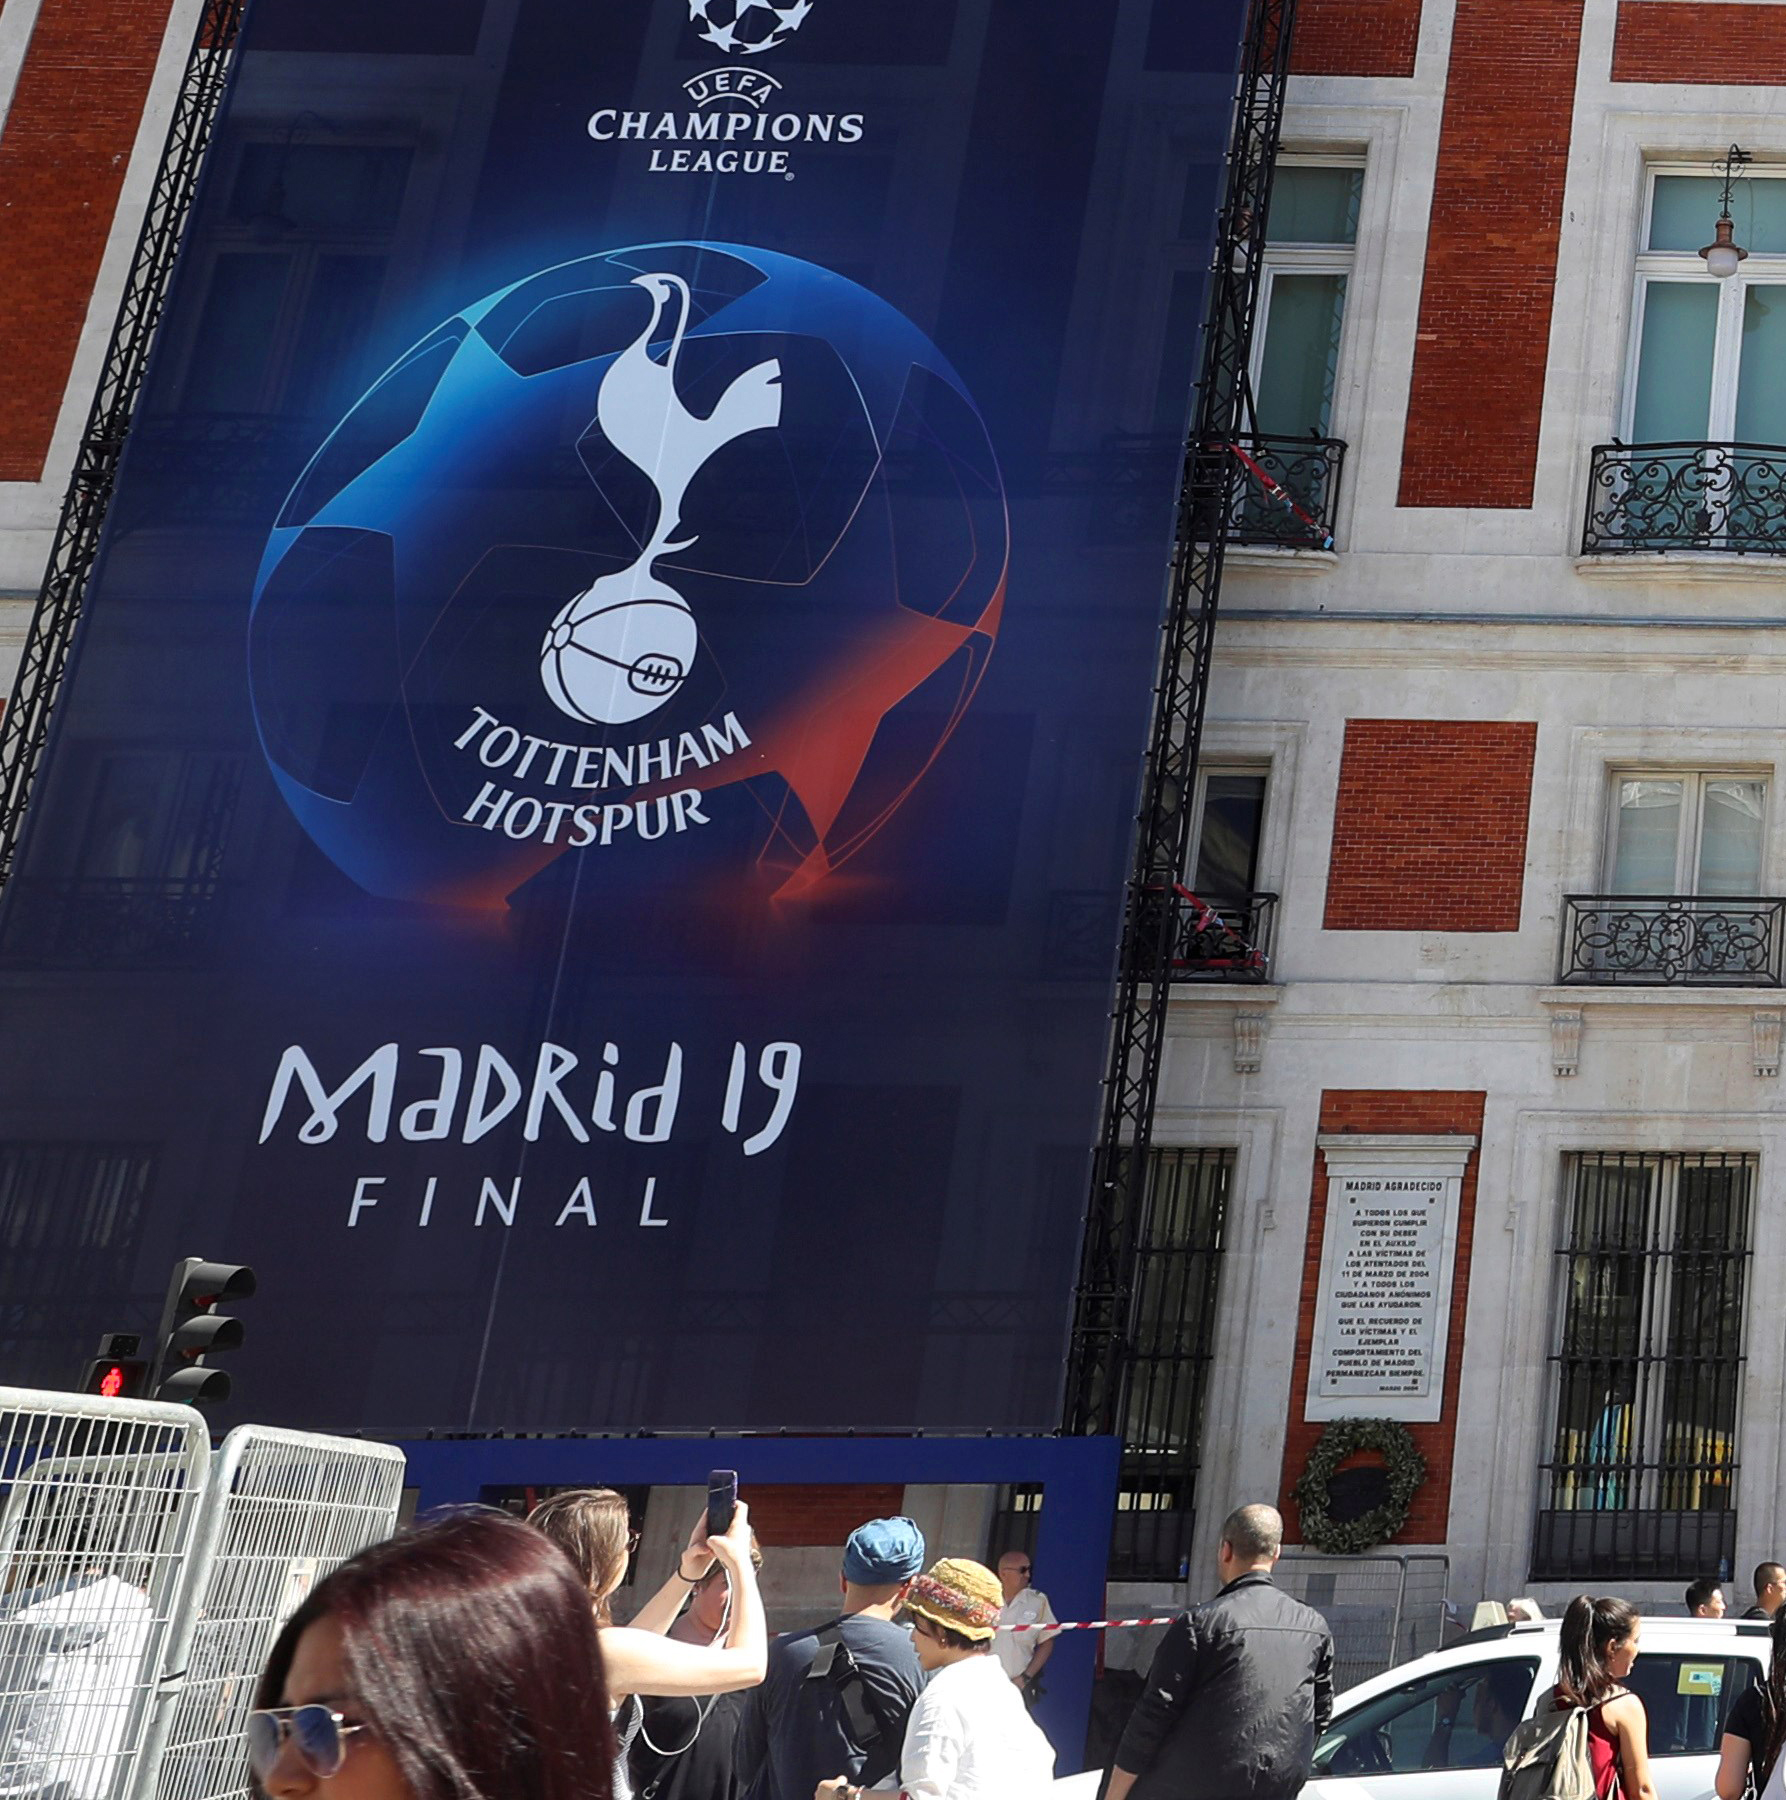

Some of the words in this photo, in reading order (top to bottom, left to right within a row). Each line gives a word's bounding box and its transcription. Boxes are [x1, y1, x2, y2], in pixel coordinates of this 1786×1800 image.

[687, 73, 772, 104] UEFA
[587, 109, 865, 143] CHAMPIONS
[648, 149, 789, 174] LEAGUE
[453, 706, 752, 789] TOTTENHAM
[462, 781, 711, 847] HOTSPUR
[721, 1041, 802, 1157] 19
[347, 1176, 670, 1228] FINAL
[1345, 1181, 1381, 1192] MADRID
[1384, 1181, 1443, 1192] AGRADECIDO
[1346, 1260, 1360, 1268] LOS
[1364, 1260, 1409, 1268] ATENTADOS
[1412, 1260, 1426, 1268] DEL
[1356, 1250, 1372, 1258] LAS
[1416, 1250, 1426, 1258] DE
[1358, 1338, 1400, 1346] EJEMPLAR
